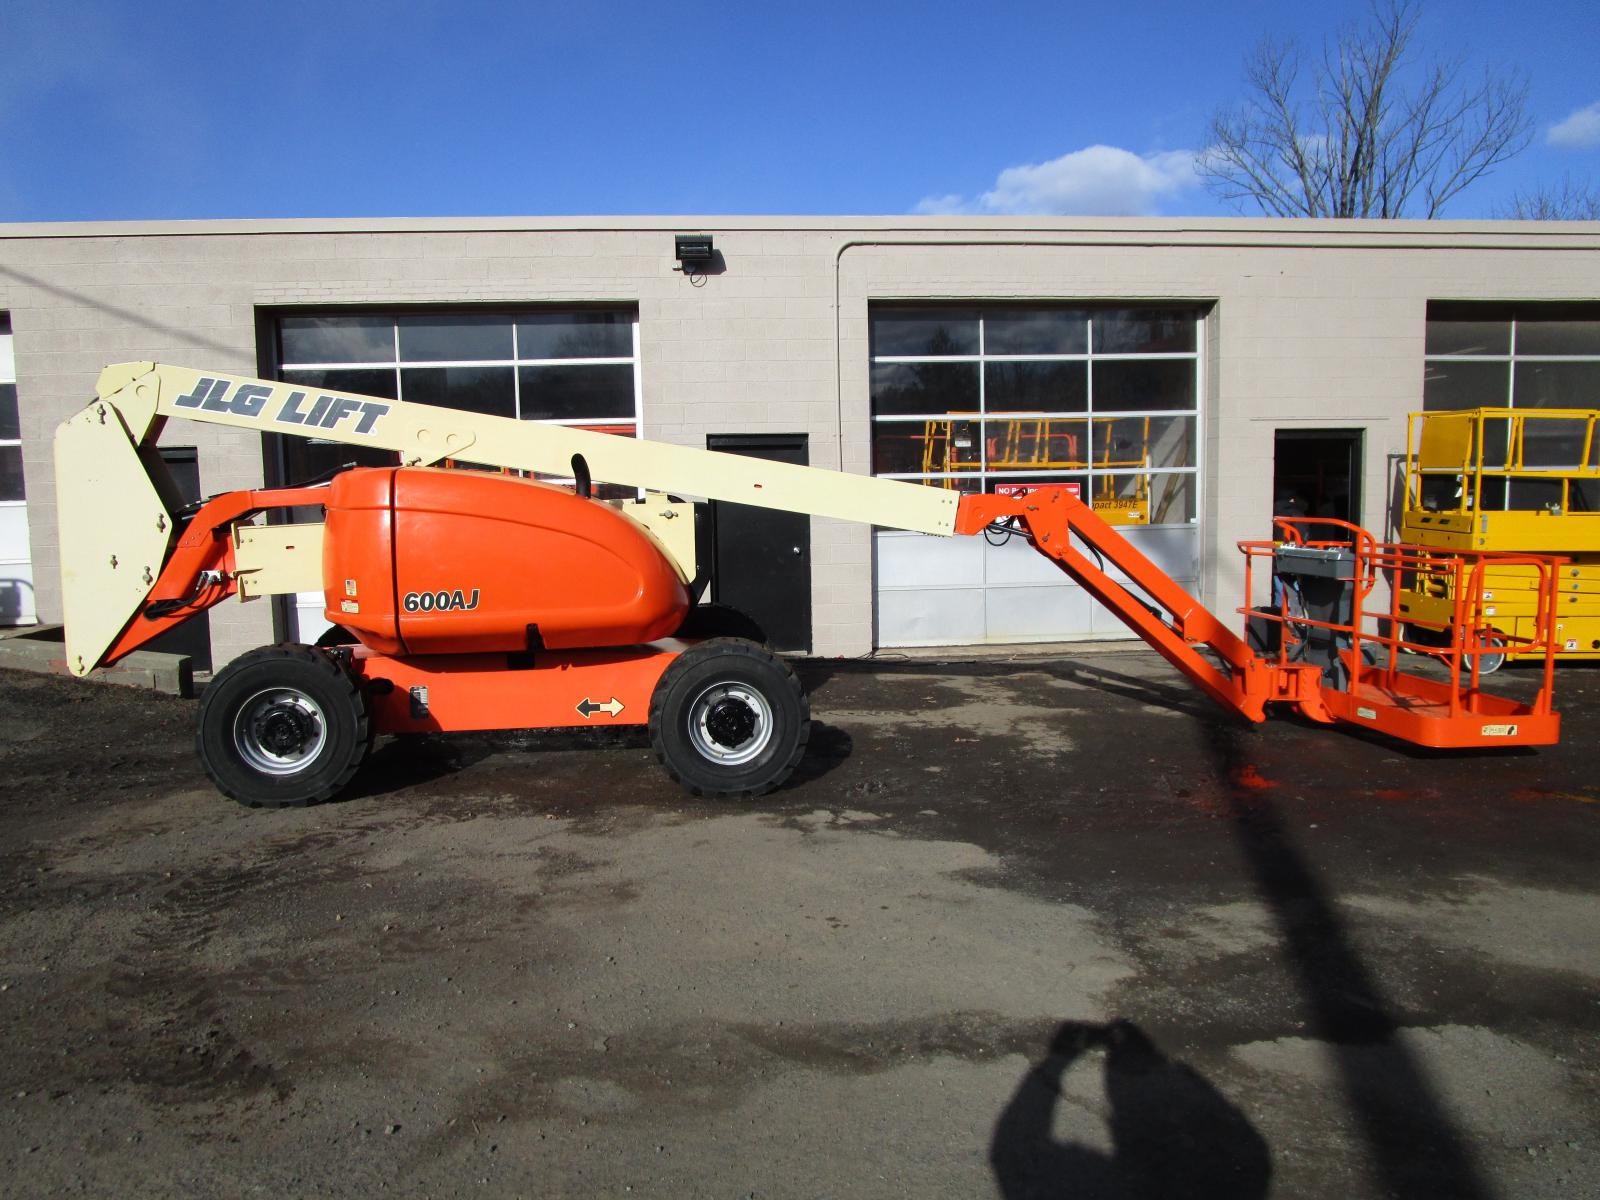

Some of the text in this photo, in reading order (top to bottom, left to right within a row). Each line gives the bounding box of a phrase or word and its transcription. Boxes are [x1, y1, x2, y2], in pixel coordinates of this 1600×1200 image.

[174, 377, 391, 434] JLG LIFT
[998, 487, 1010, 495] NO
[403, 589, 480, 612] 600AJ
